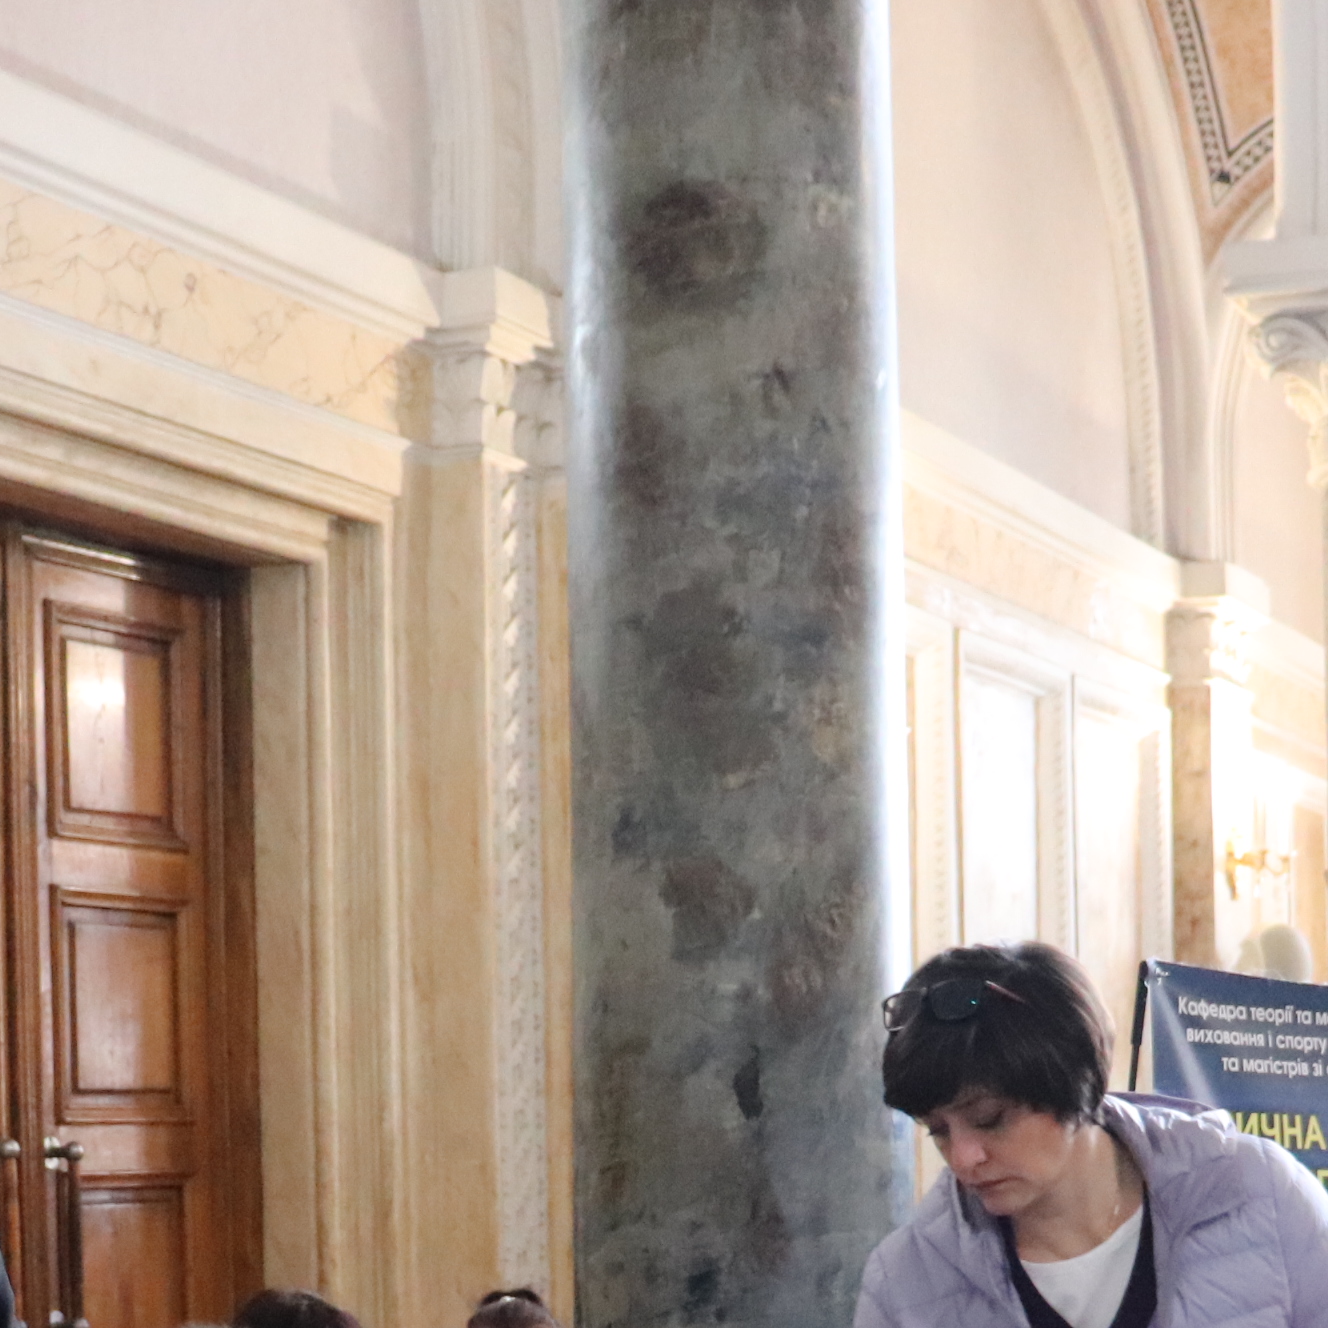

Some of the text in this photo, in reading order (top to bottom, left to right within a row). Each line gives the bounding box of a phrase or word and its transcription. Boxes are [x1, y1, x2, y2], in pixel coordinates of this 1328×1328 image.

[1178, 996, 1247, 1021] Кафедра
[1250, 1005, 1294, 1026] теорії
[1296, 1010, 1312, 1025] та
[1186, 1028, 1265, 1047] виховання
[1268, 1030, 1273, 1048] і
[1276, 1034, 1327, 1054] спорту
[1221, 1057, 1239, 1072] та
[1243, 1057, 1309, 1078] магістрів
[1312, 1060, 1323, 1077] зі
[1233, 1112, 1327, 1150] ИЧНА
